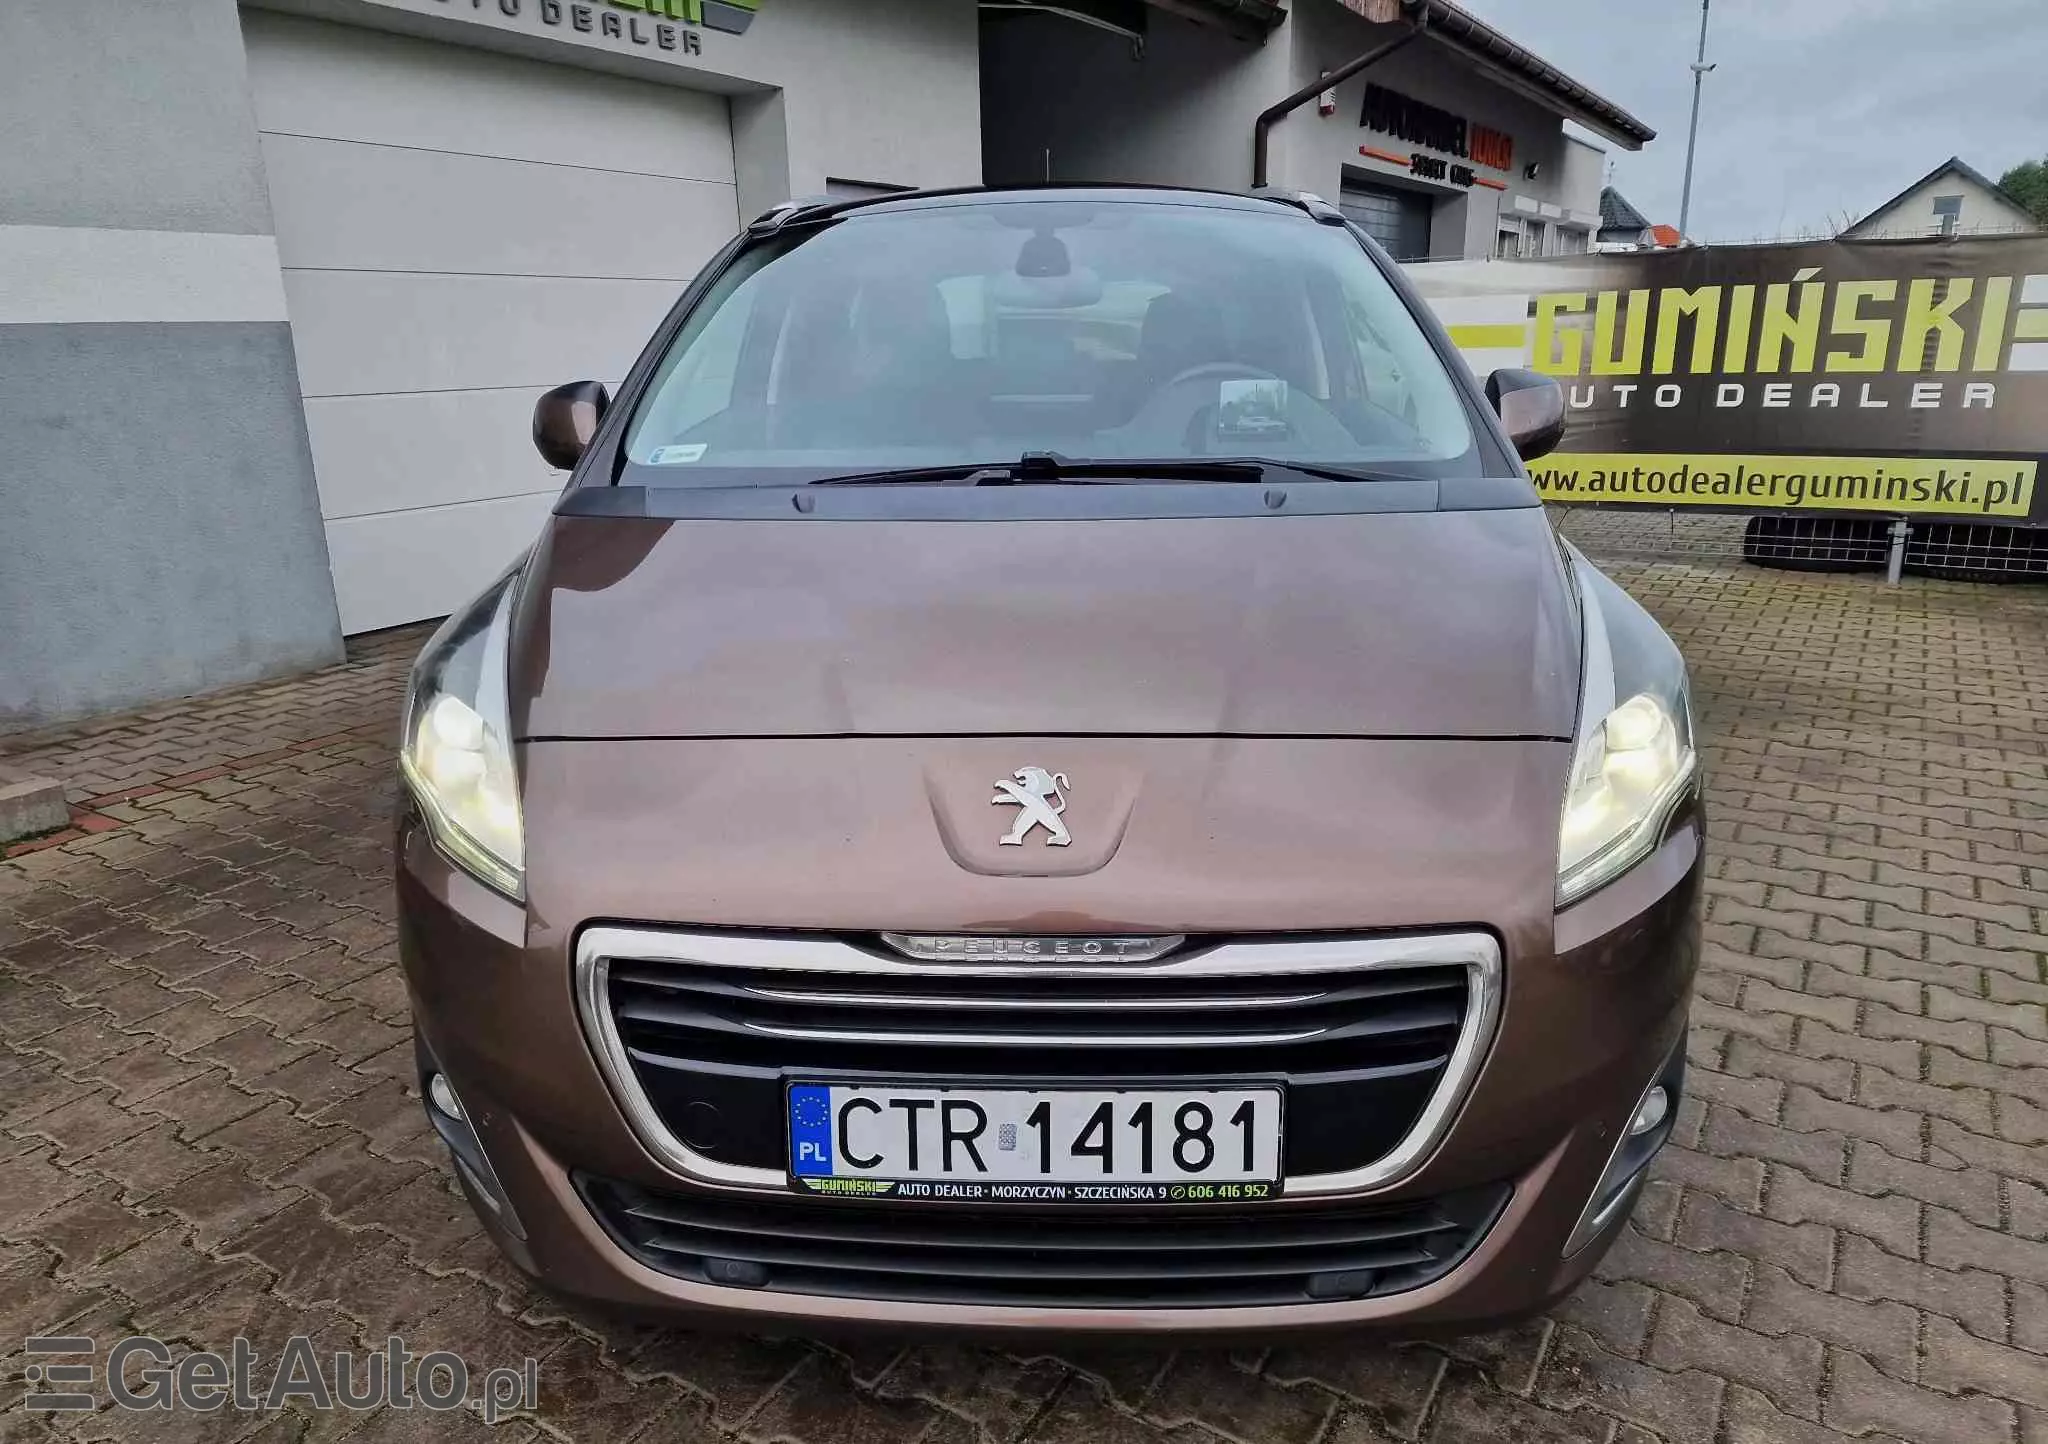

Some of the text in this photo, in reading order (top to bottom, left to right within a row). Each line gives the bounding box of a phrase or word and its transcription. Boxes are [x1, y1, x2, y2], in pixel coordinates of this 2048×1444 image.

[540, 0, 702, 56] DEALER
[1532, 267, 2012, 376] GUMIŃSKI
[1569, 383, 1996, 409] UTO DEALER
[1527, 463, 2024, 512] ww.autodealerguminski.pl
[800, 1142, 827, 1162] PL
[838, 1097, 1255, 1174] CTR 14181
[898, 1184, 931, 1196] AUTO
[1074, 1184, 1155, 1199] SZCZECIŃSKA
[1158, 1186, 1167, 1199] 9
[1188, 1186, 1214, 1198] 606
[1218, 1185, 1240, 1198] 416
[1244, 1184, 1269, 1197] 952
